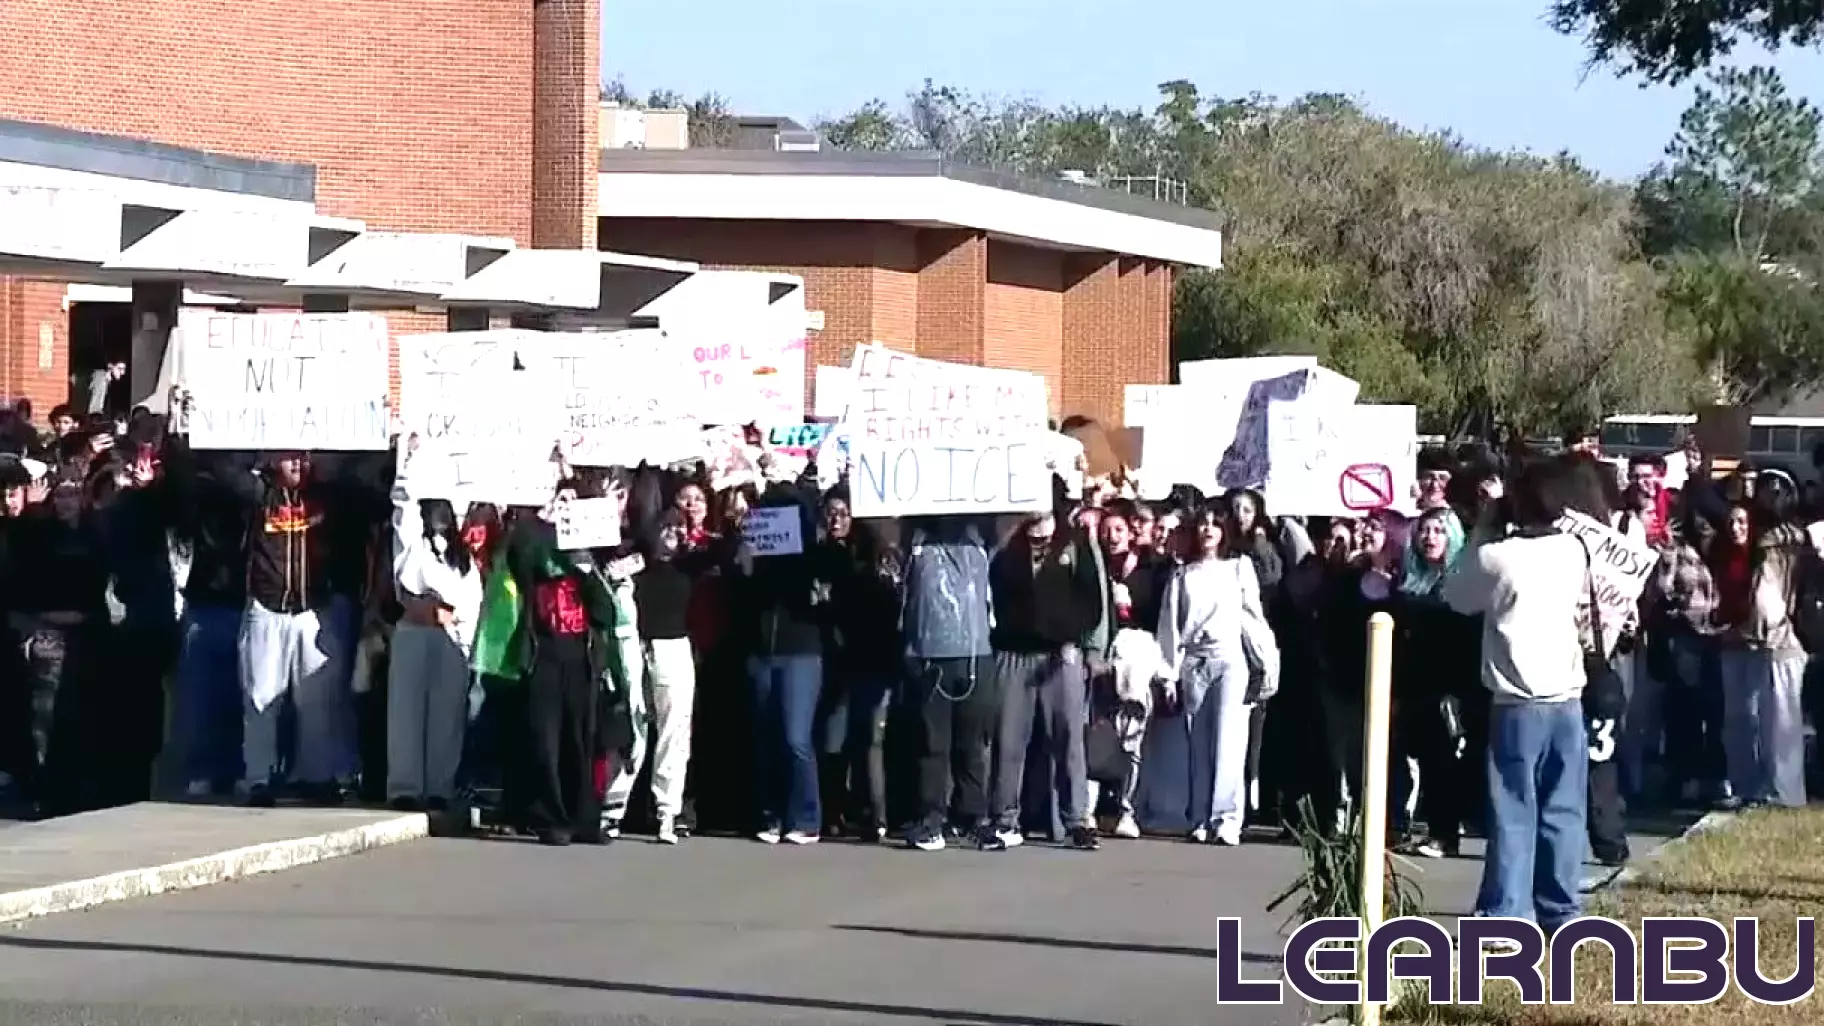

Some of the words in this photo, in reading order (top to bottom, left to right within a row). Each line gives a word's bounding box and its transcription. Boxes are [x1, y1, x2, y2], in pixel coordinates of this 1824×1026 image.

[693, 343, 731, 364] OUR
[245, 356, 316, 393] NOT
[699, 368, 723, 390] TO
[858, 447, 920, 506] NO
[932, 442, 1038, 504] ICE
[1588, 718, 1616, 762] 3
